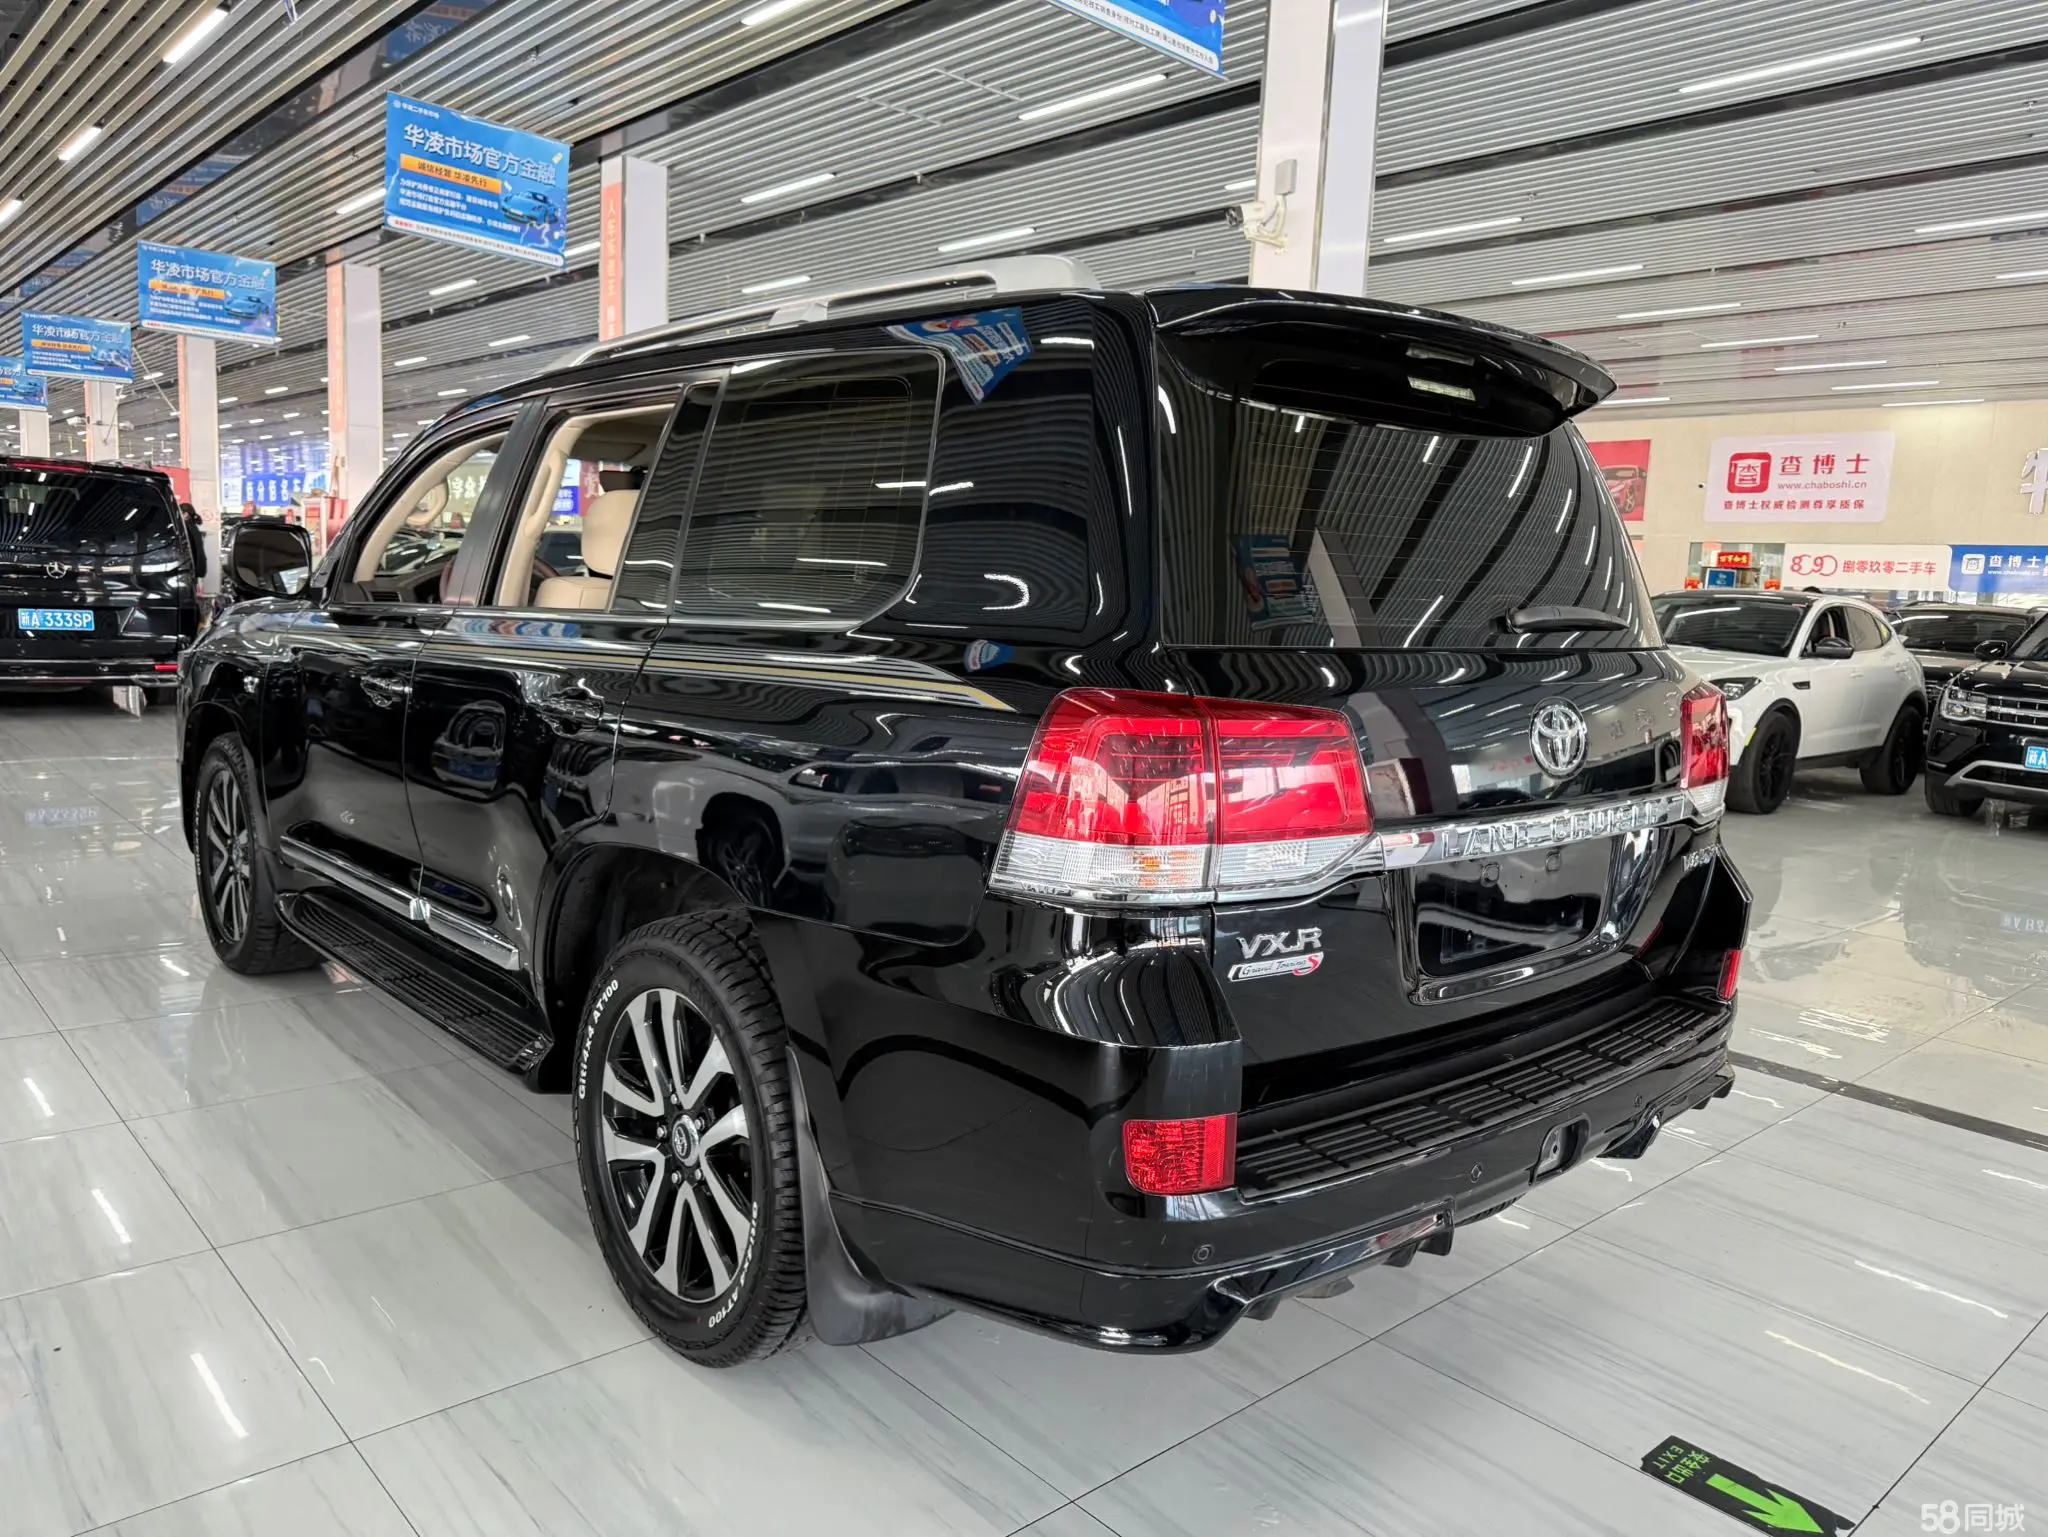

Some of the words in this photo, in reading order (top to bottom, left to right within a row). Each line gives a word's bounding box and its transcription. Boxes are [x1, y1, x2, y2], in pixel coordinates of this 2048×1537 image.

[404, 123, 557, 186] 华凌市场官方金融
[1779, 453, 1870, 476] 查博士
[1777, 479, 1868, 491] www.chaboshi.cn
[1842, 560, 1937, 577] 捌零玖零二手车
[1988, 554, 2042, 569] 查博士
[1441, 821, 1530, 860] LAND
[593, 979, 619, 1025] AT100
[1652, 1444, 1684, 1470] EXIT
[1664, 1450, 1711, 1484] 安全出口
